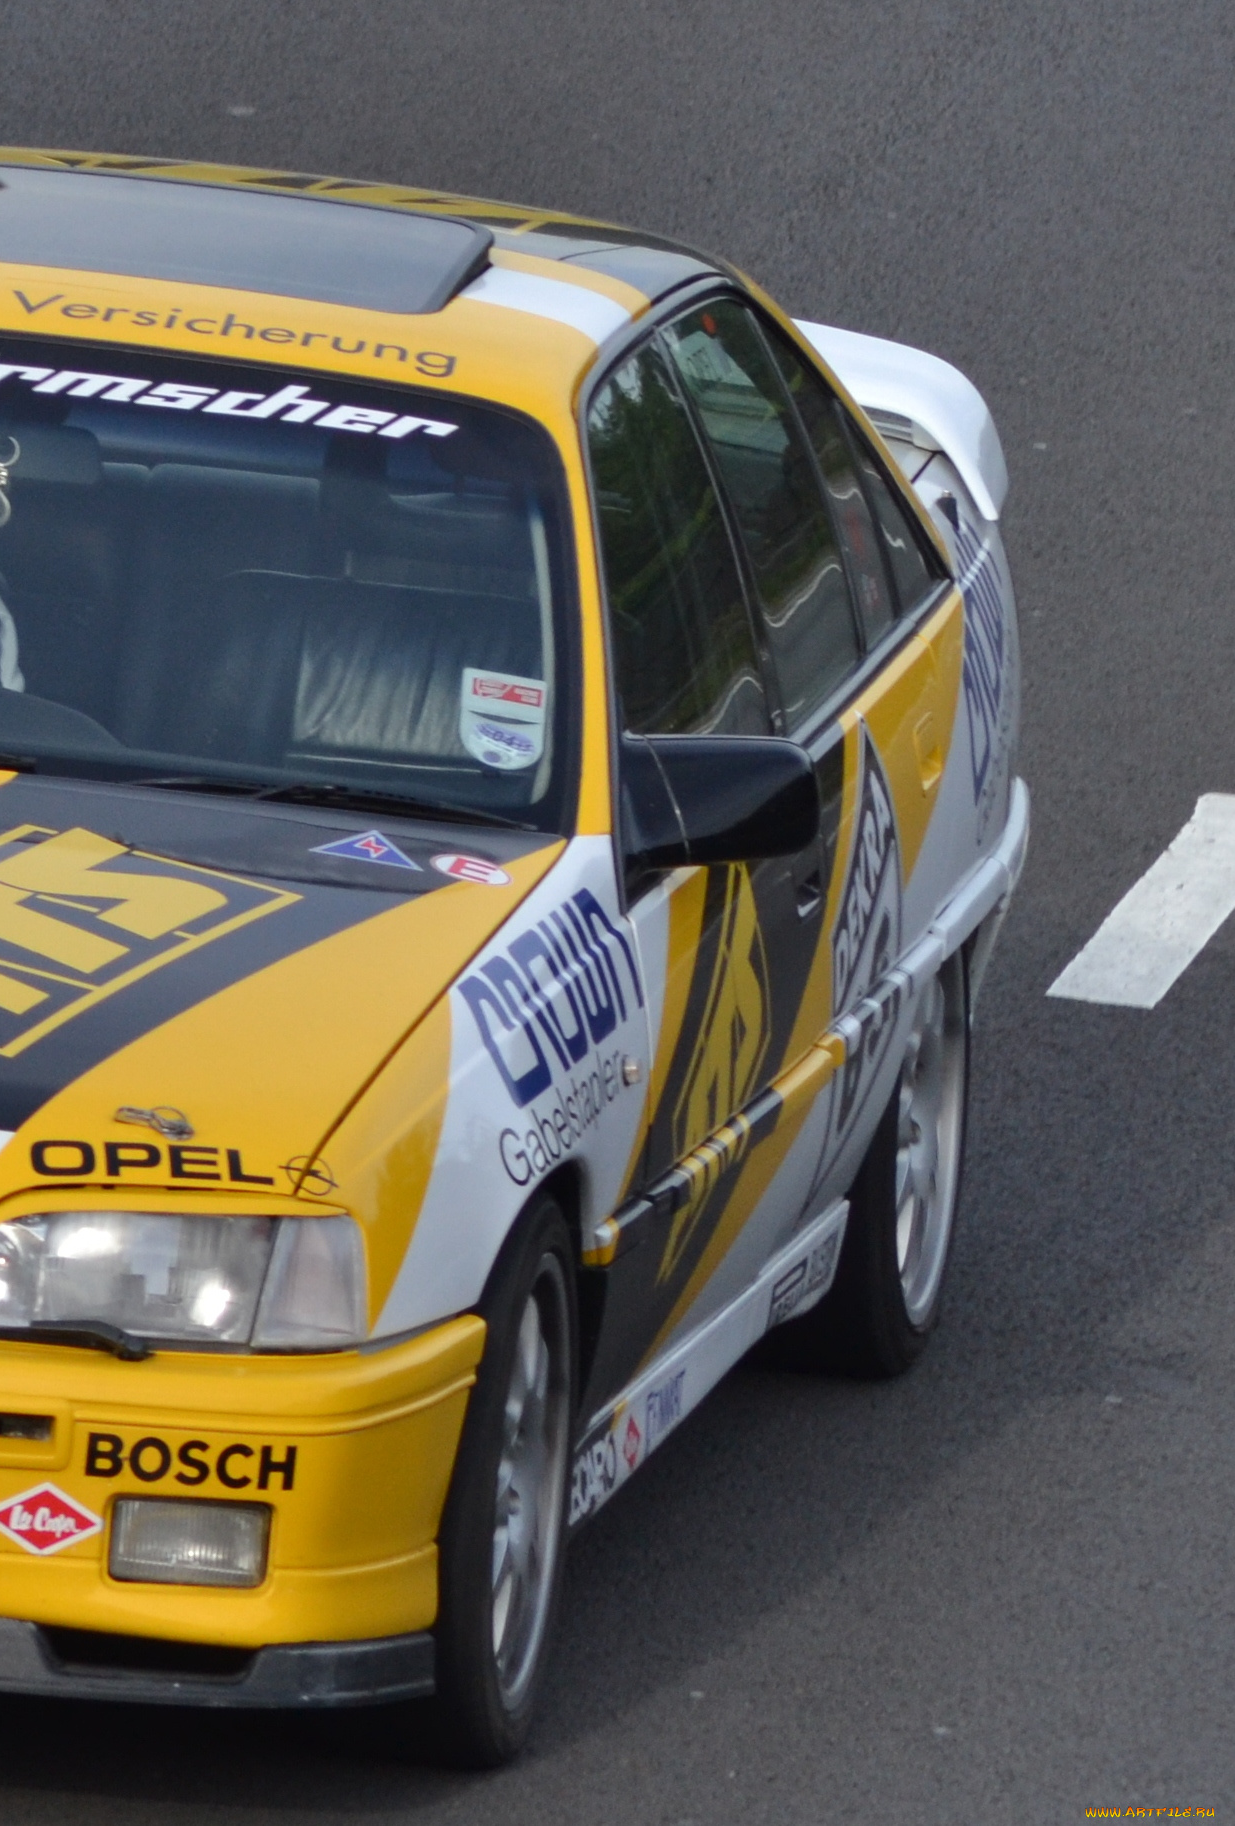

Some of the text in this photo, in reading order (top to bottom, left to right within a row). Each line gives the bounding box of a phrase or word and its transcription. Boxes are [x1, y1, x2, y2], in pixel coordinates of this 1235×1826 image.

[12, 289, 459, 379] Versicherung
[499, 1048, 622, 1188] Gabelstapler
[30, 1139, 276, 1186] OPEL
[84, 1432, 298, 1491] BOSCH
